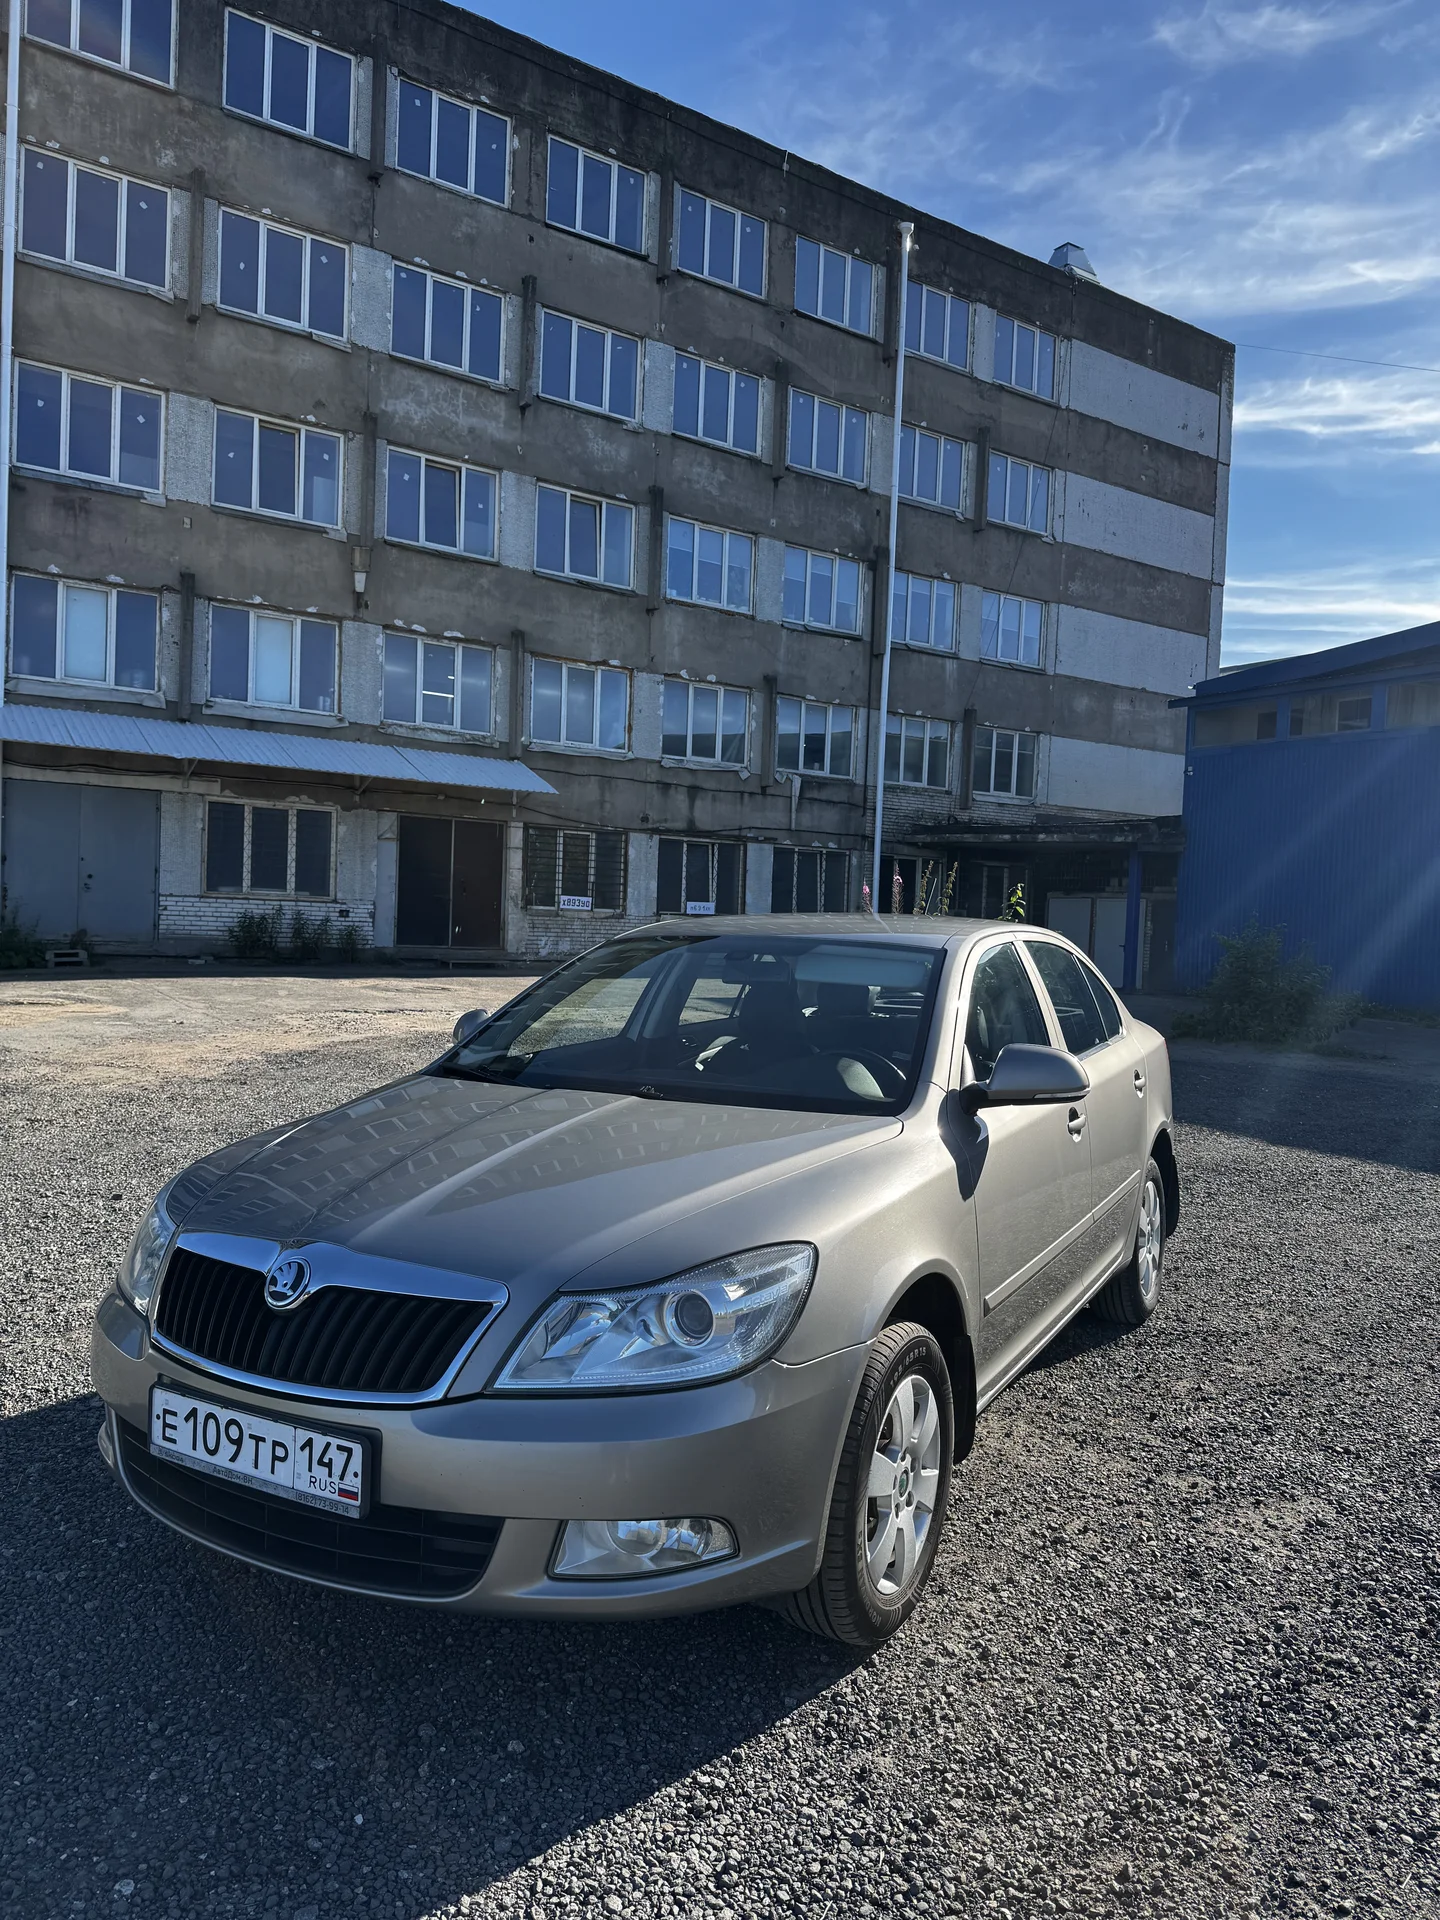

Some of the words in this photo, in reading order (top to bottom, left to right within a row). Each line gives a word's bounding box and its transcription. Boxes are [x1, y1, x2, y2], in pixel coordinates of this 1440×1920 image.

[162, 1406, 289, 1475] Е109ТР
[300, 1437, 353, 1481] 147
[308, 1475, 337, 1494] RUS
